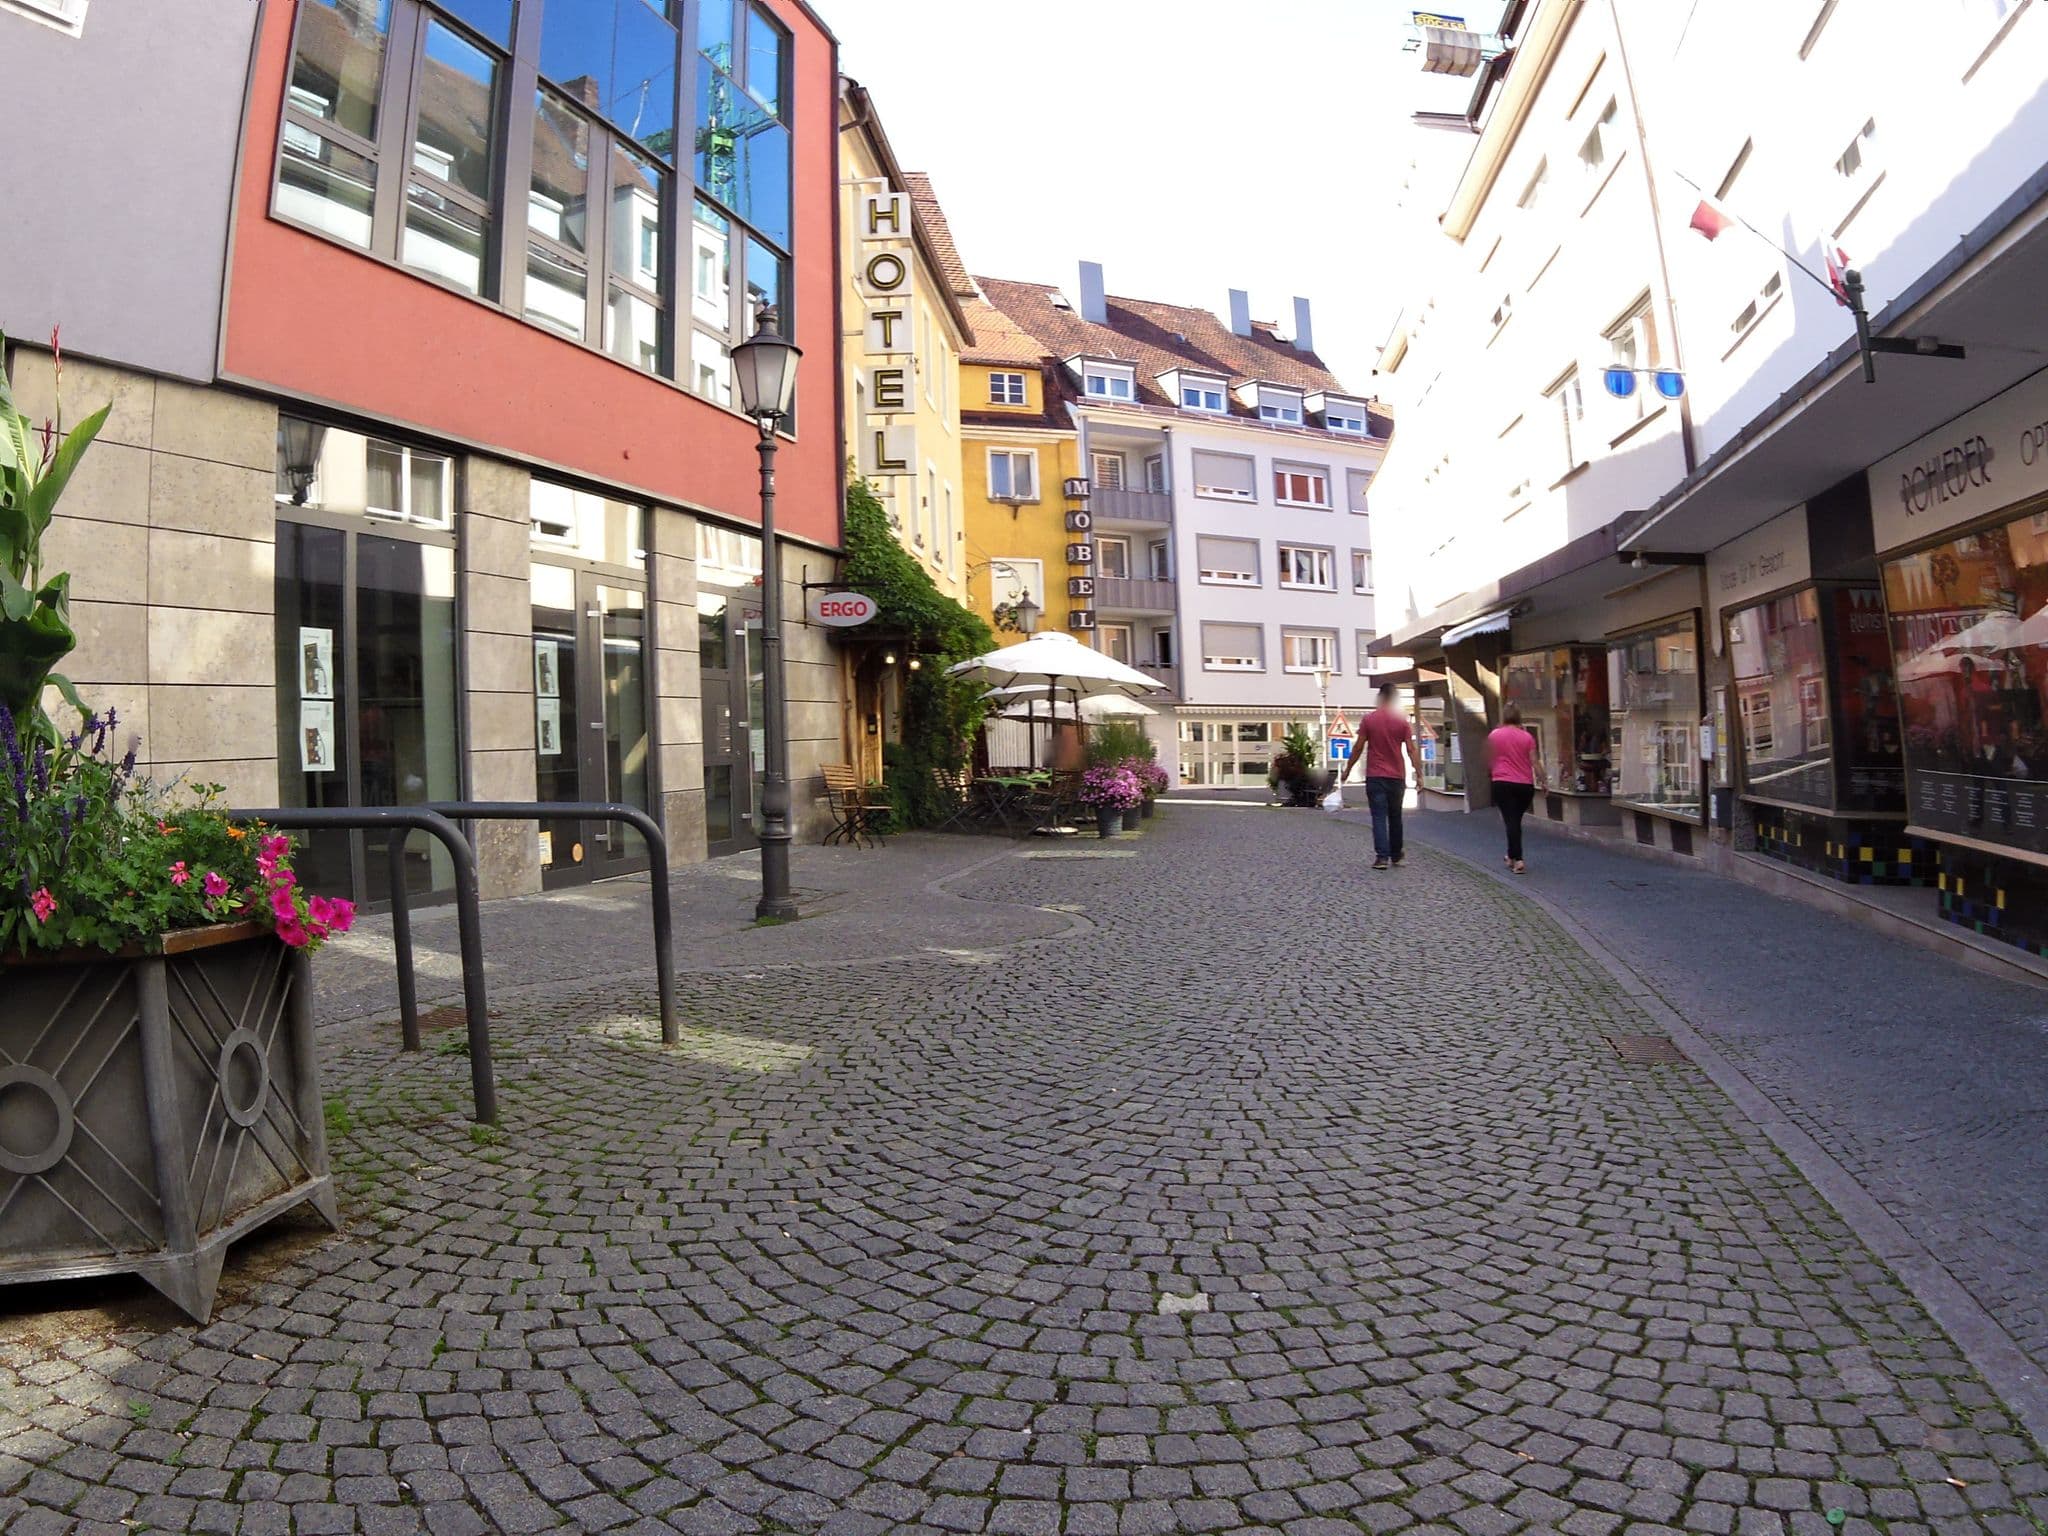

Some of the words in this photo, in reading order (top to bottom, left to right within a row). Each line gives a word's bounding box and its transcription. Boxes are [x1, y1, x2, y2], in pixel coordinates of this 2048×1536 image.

[866, 196, 907, 471] HOTEL
[1900, 434, 1993, 518] ROHLEDER
[819, 601, 869, 618] ERGO
